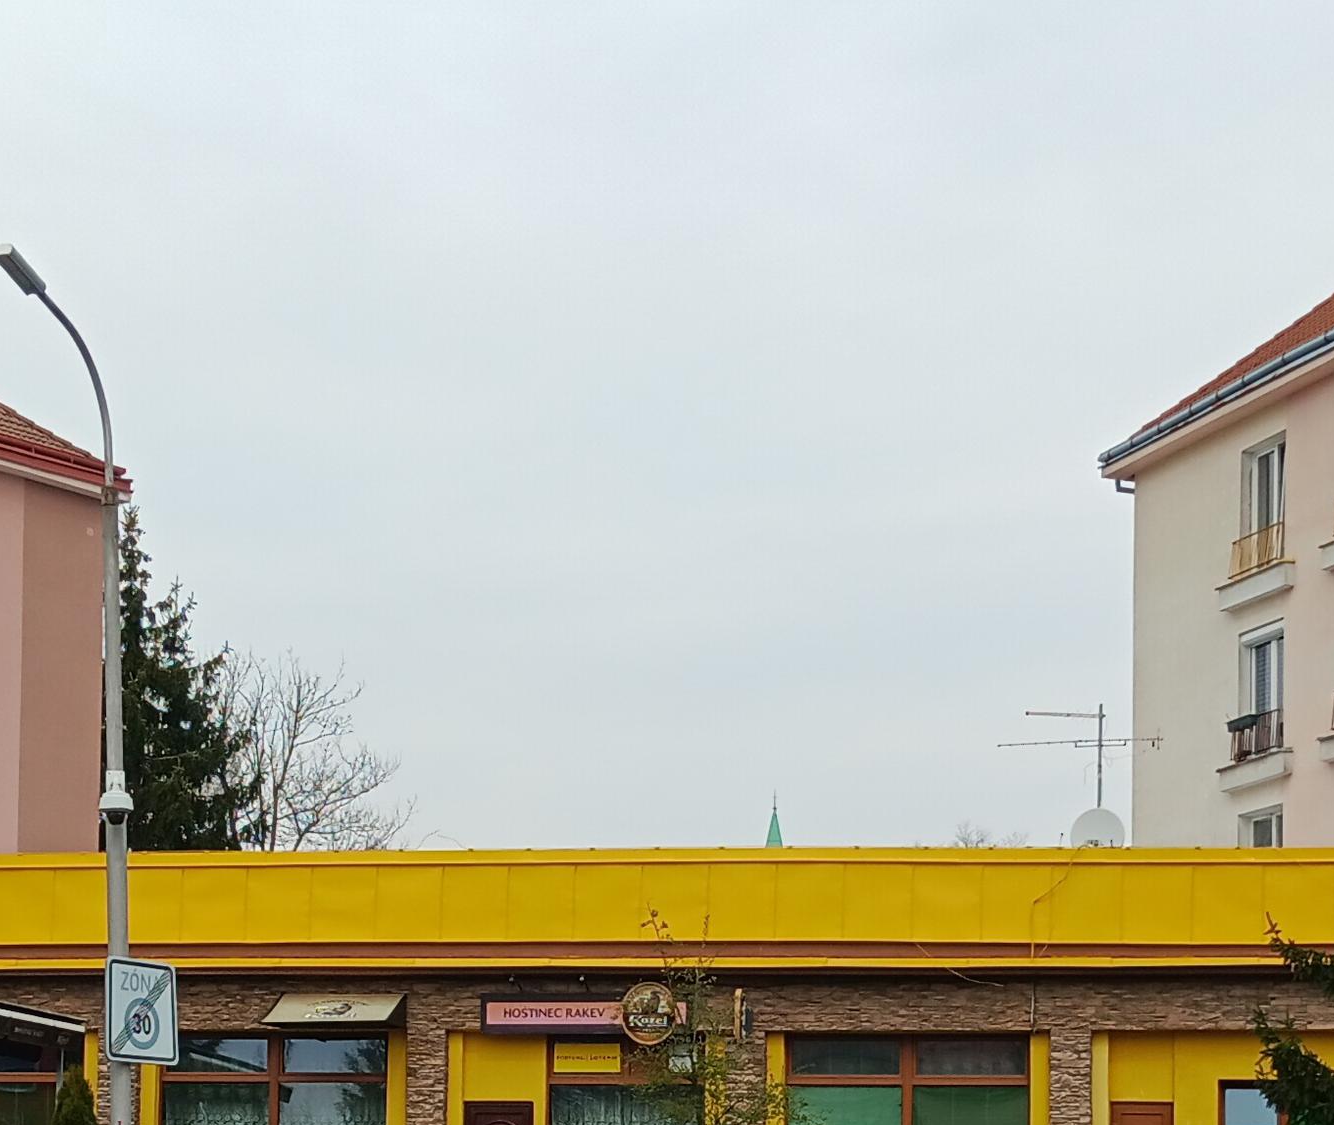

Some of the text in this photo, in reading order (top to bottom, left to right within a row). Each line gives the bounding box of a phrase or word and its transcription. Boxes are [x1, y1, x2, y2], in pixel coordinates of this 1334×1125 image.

[120, 968, 160, 993] ZÓN
[503, 1007, 605, 1018] HOSTINEC RAKEV
[132, 1013, 151, 1034] 30
[629, 1015, 667, 1027] Kozel
